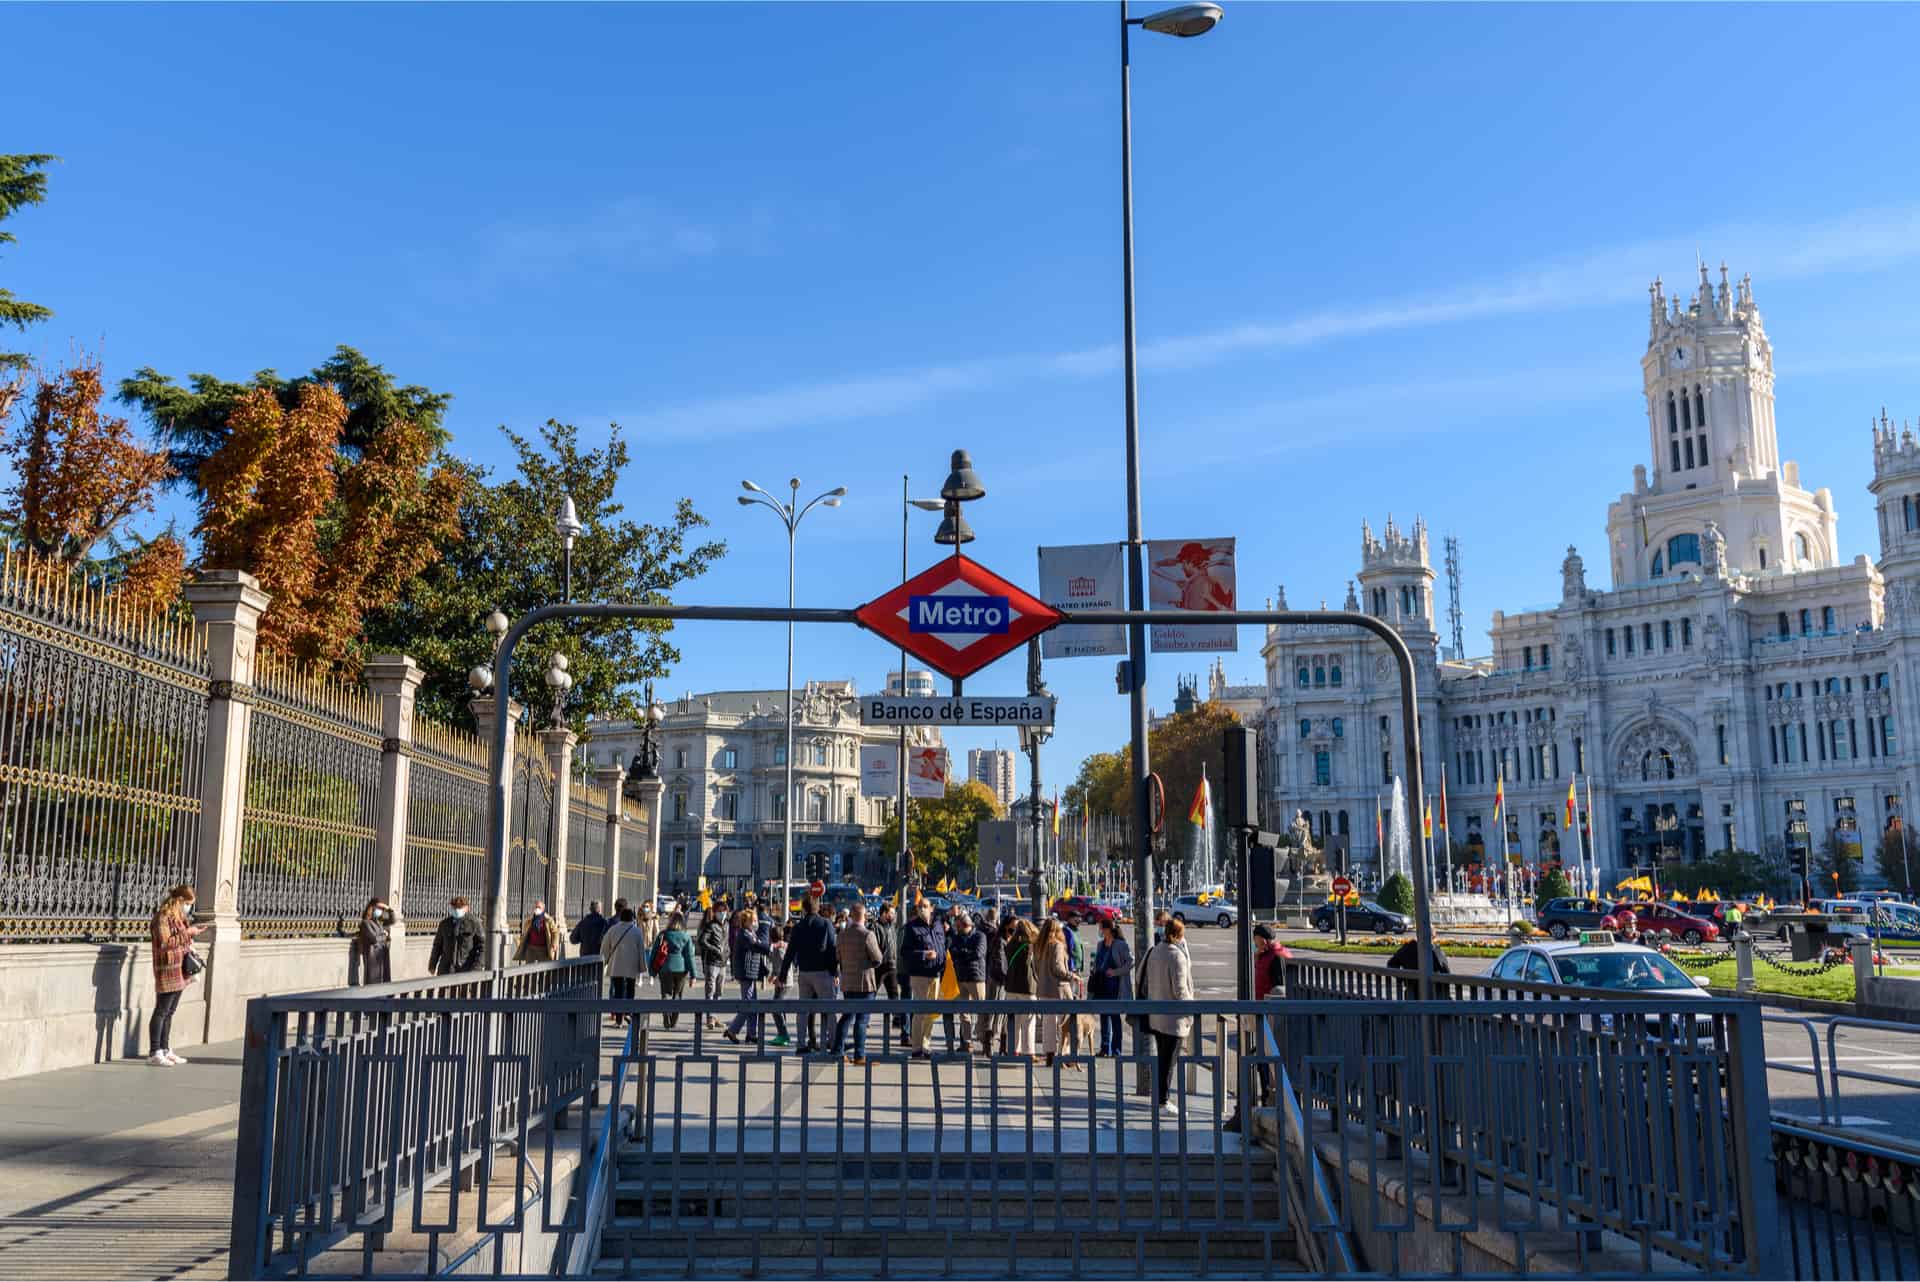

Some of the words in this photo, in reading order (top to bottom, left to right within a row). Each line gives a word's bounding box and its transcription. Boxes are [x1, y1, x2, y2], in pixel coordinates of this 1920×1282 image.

[918, 601, 1002, 626] Metro
[872, 702, 934, 720] Banco
[940, 702, 964, 720] de
[971, 702, 1043, 723] España
